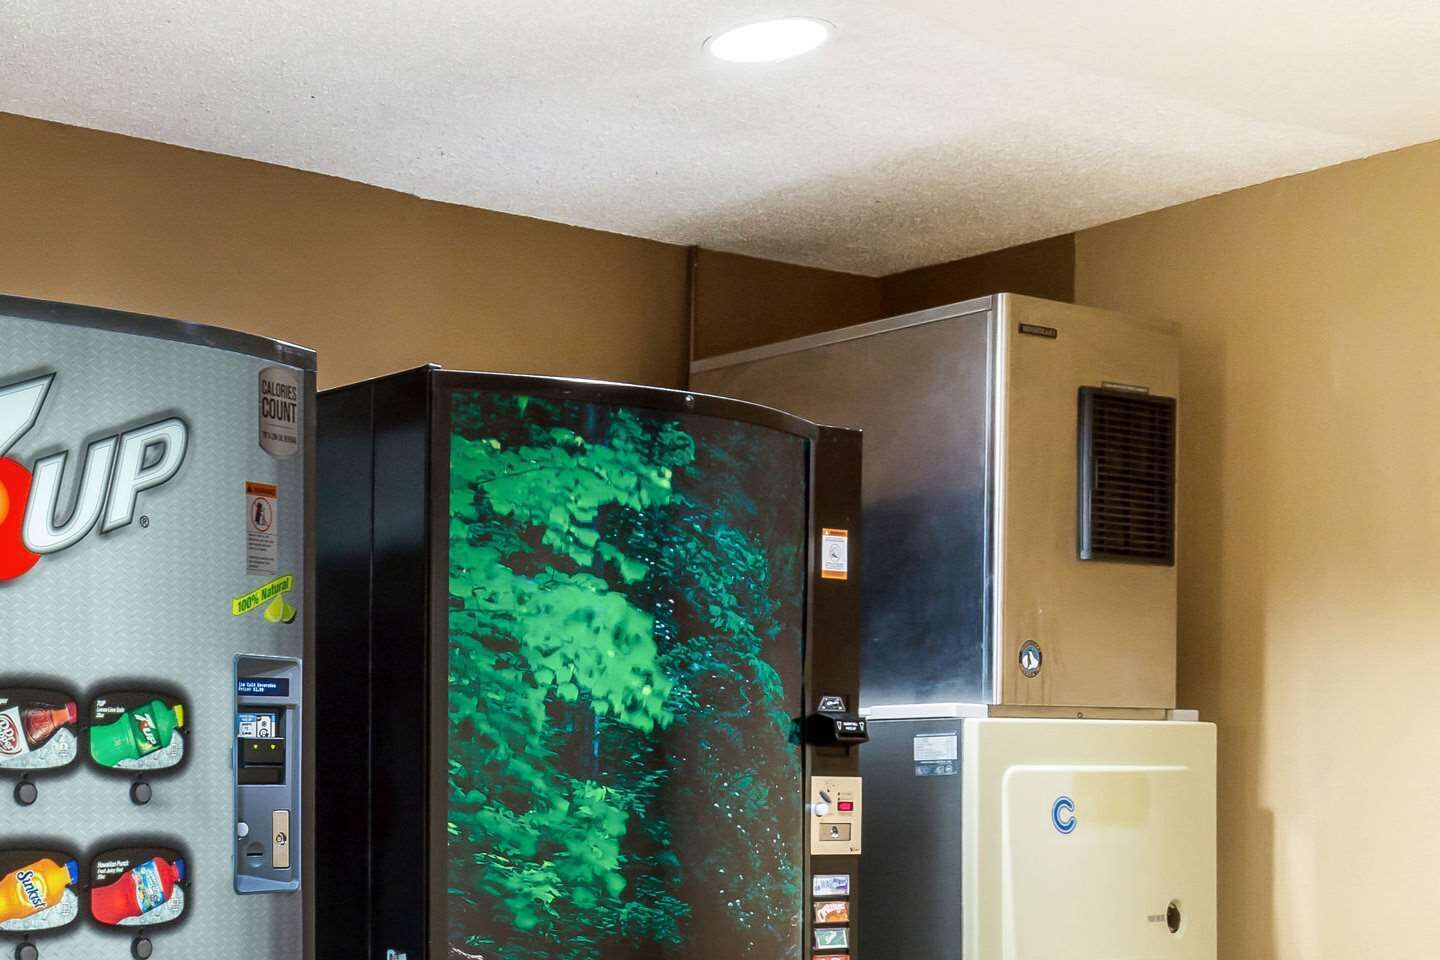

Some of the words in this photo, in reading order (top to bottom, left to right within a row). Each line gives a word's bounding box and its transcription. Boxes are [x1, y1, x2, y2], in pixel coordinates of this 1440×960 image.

[262, 380, 297, 401] CALORIES
[262, 397, 297, 423] COUNT
[238, 594, 259, 613] 100%
[261, 577, 290, 601] Natural
[1051, 796, 1078, 835] C
[16, 870, 47, 910] Sunkist
